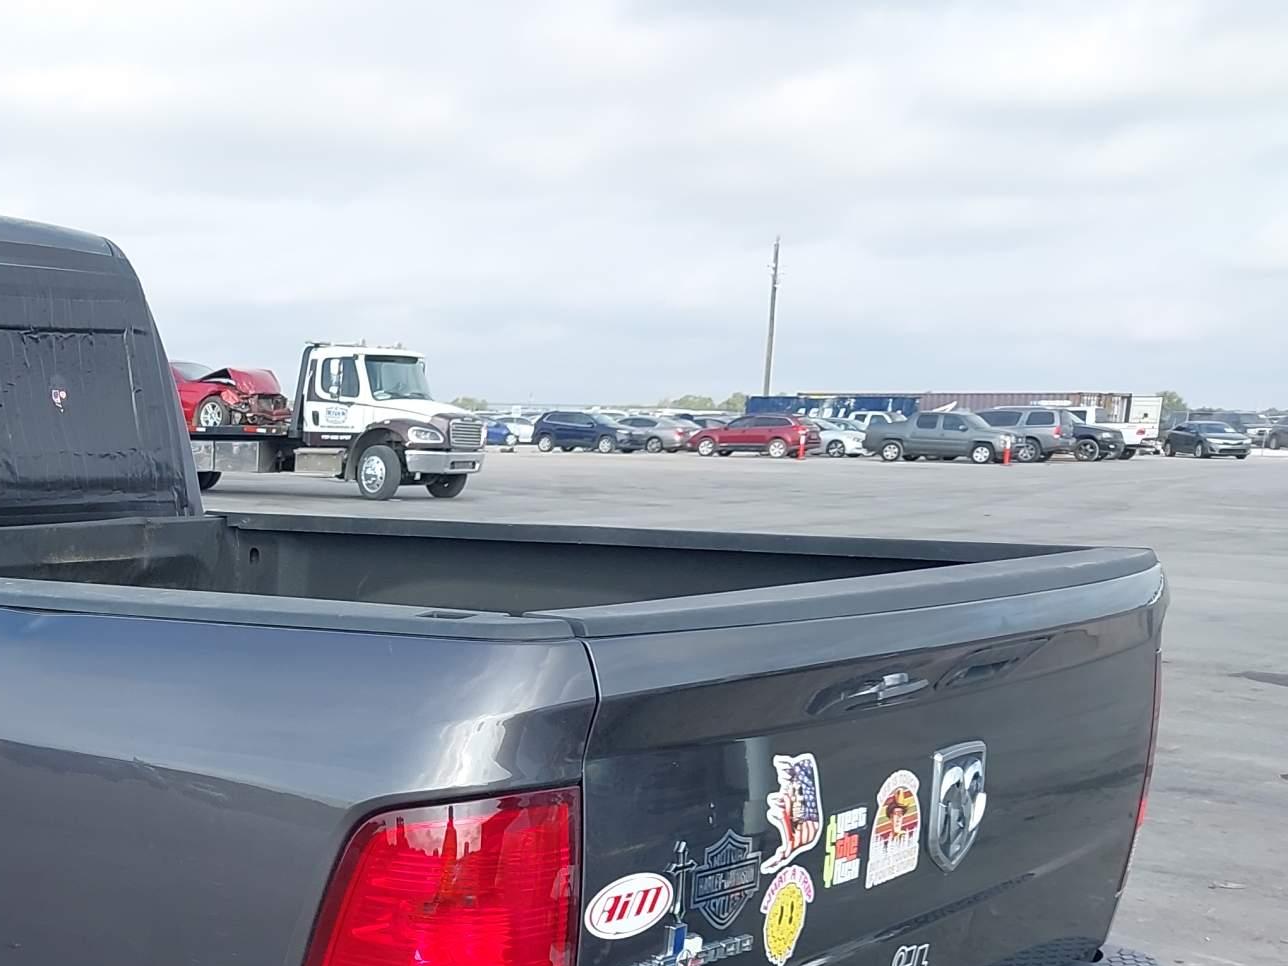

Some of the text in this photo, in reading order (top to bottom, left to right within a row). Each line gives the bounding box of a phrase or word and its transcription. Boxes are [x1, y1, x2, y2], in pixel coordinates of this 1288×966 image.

[762, 869, 789, 911] WHAT
[790, 867, 797, 880] A
[798, 870, 813, 901] TRIP
